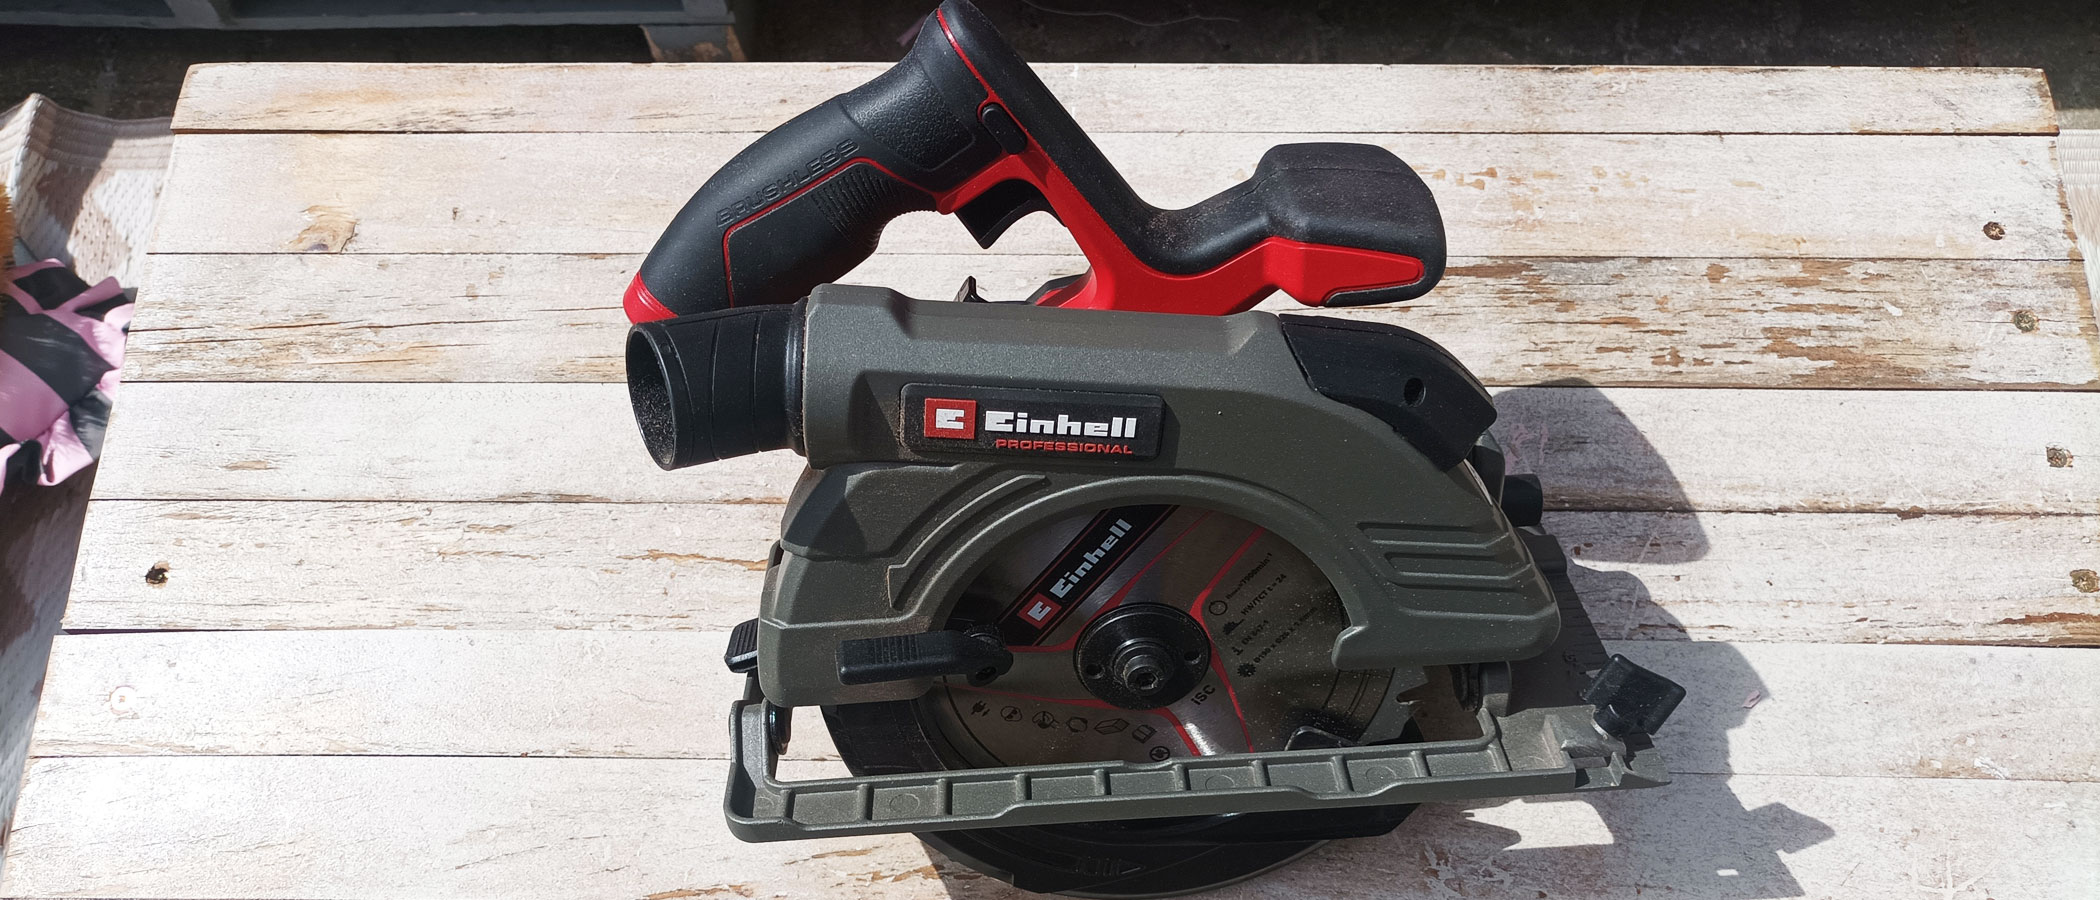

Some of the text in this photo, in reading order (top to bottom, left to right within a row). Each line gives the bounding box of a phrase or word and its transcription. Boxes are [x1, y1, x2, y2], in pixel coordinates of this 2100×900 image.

[716, 138, 860, 227] BRUSHLESS
[985, 410, 1137, 438] Einhell
[996, 439, 1133, 454] PROFESSIONAL
[1049, 518, 1132, 599] Einhell
[1240, 589, 1268, 616] HW/TCT
